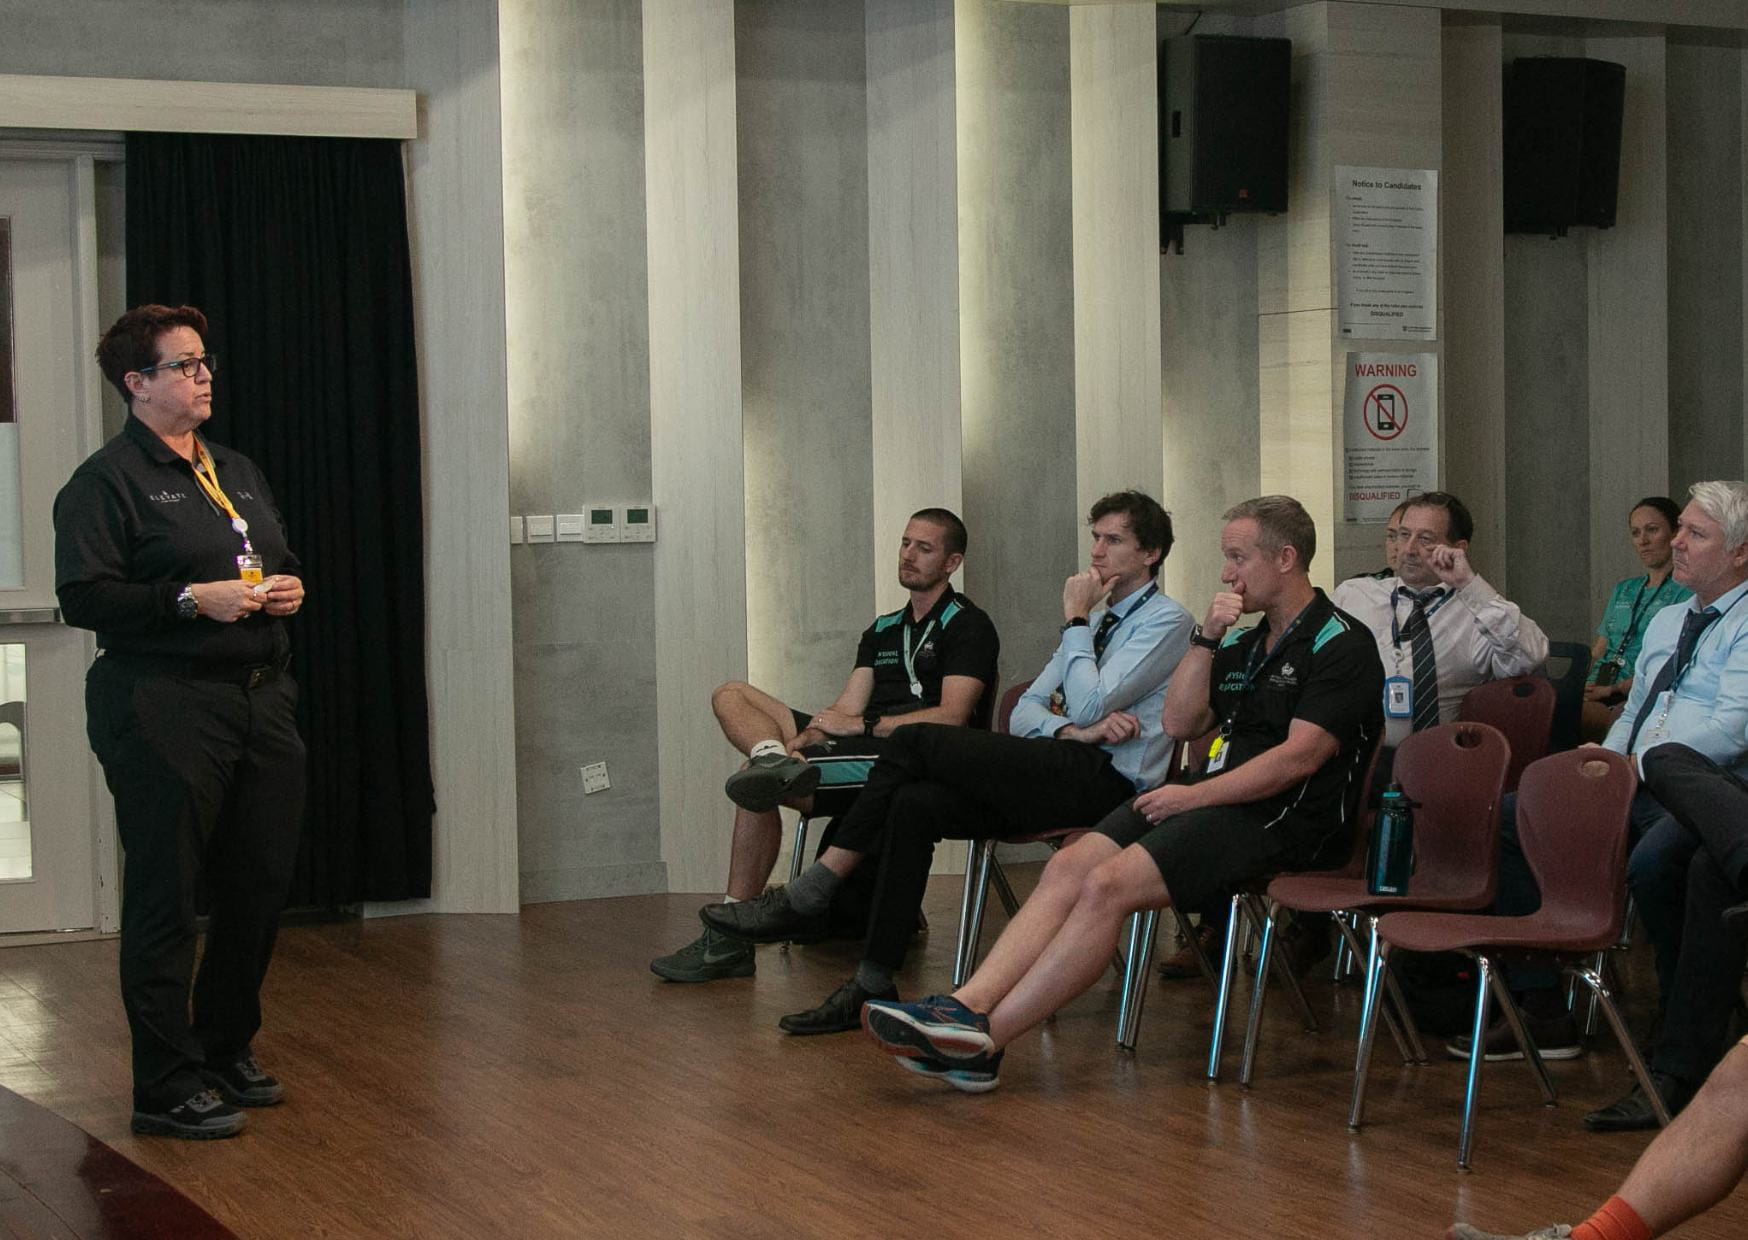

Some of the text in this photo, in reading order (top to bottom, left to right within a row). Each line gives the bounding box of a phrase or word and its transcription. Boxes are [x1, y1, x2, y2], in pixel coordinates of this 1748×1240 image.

[1352, 179, 1422, 191] Notice to Candidates
[1355, 364, 1417, 377] WARNING
[1349, 491, 1401, 501] DISQUALIFIED
